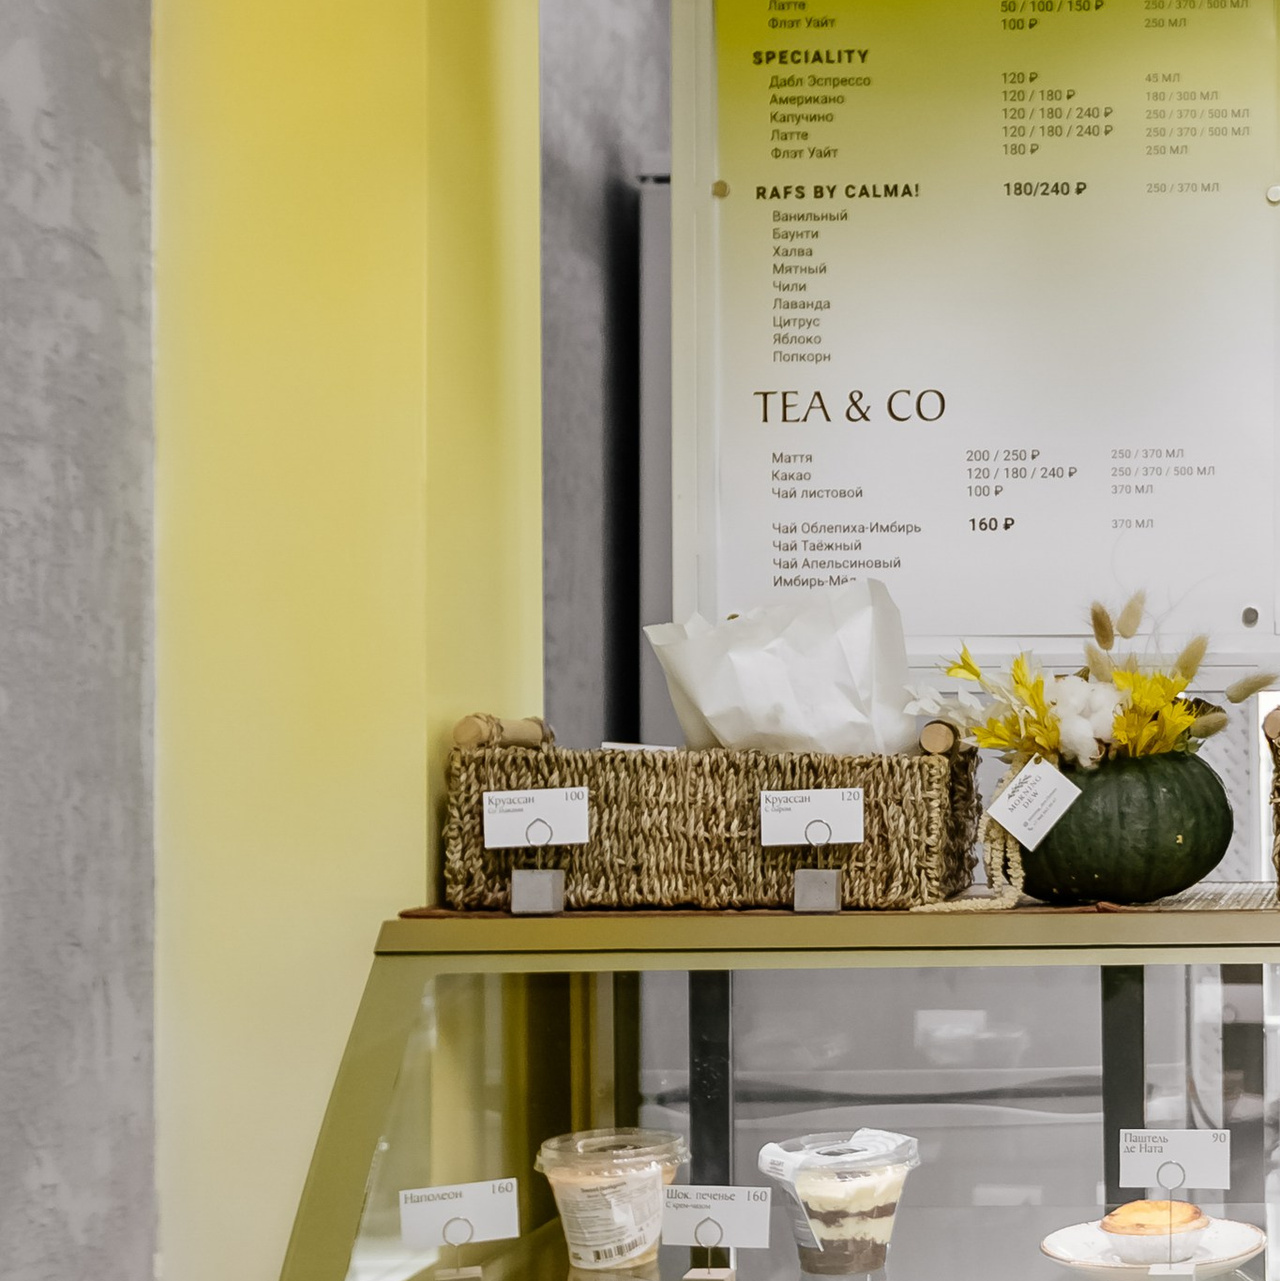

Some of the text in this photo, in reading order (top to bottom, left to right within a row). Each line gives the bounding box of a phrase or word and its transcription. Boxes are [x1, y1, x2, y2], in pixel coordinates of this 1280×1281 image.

[1000, 0, 1091, 13] 50 100 150
[767, 16, 836, 30] Флэт Уайт
[1001, 17, 1025, 31] 100
[752, 49, 869, 66] SPECIALITY
[768, 74, 872, 90] Дабл Эспрессо
[1001, 71, 1026, 85] 120
[769, 93, 845, 108] Американо
[1001, 88, 1063, 102] 120 180
[769, 110, 834, 126] Капучино
[1001, 106, 1100, 120] 120 180 240
[770, 128, 809, 142] Латте
[1001, 124, 1101, 138] 120 180 240
[770, 146, 839, 160] Флэт Уайт
[1002, 142, 1026, 156] 180
[756, 183, 919, 200] RAFS BY CALMA!
[1003, 181, 1071, 197] 180/240
[772, 208, 848, 223] Ванильный
[772, 227, 819, 243] Баунти
[772, 245, 813, 258] Халва
[772, 262, 827, 275] Мятный
[772, 280, 807, 293] Чили
[772, 297, 831, 312] Лаванда
[772, 315, 820, 330] Цитрус
[772, 332, 822, 345] Яблоко
[772, 350, 831, 365] Попкорн
[753, 389, 946, 423] TEA & CO
[771, 452, 813, 464] Маття
[965, 449, 1027, 462] 200 250
[771, 469, 812, 482] Какао
[967, 466, 1065, 480] 120 180 240
[771, 486, 863, 499] Чай листовой
[967, 484, 991, 498] 100
[772, 520, 922, 536] Чай Облепиха-Имбирь
[968, 517, 998, 532] 160
[772, 539, 862, 552] Чай Таёжный
[772, 556, 902, 570] Чай Апельсиновый
[564, 791, 584, 801] 100
[765, 795, 810, 806] Круассан
[841, 791, 860, 801] 120
[1008, 775, 1042, 813] MORNING
[1023, 791, 1039, 809] DEW
[488, 796, 534, 807] Круассан
[1124, 1133, 1168, 1143] Паштель
[1212, 1133, 1226, 1143] 90
[1124, 1144, 1163, 1153] де Ната
[492, 1182, 513, 1194] 160
[667, 1189, 691, 1199] Шок.
[404, 1191, 462, 1204] Наполеон
[747, 1191, 767, 1201] 160
